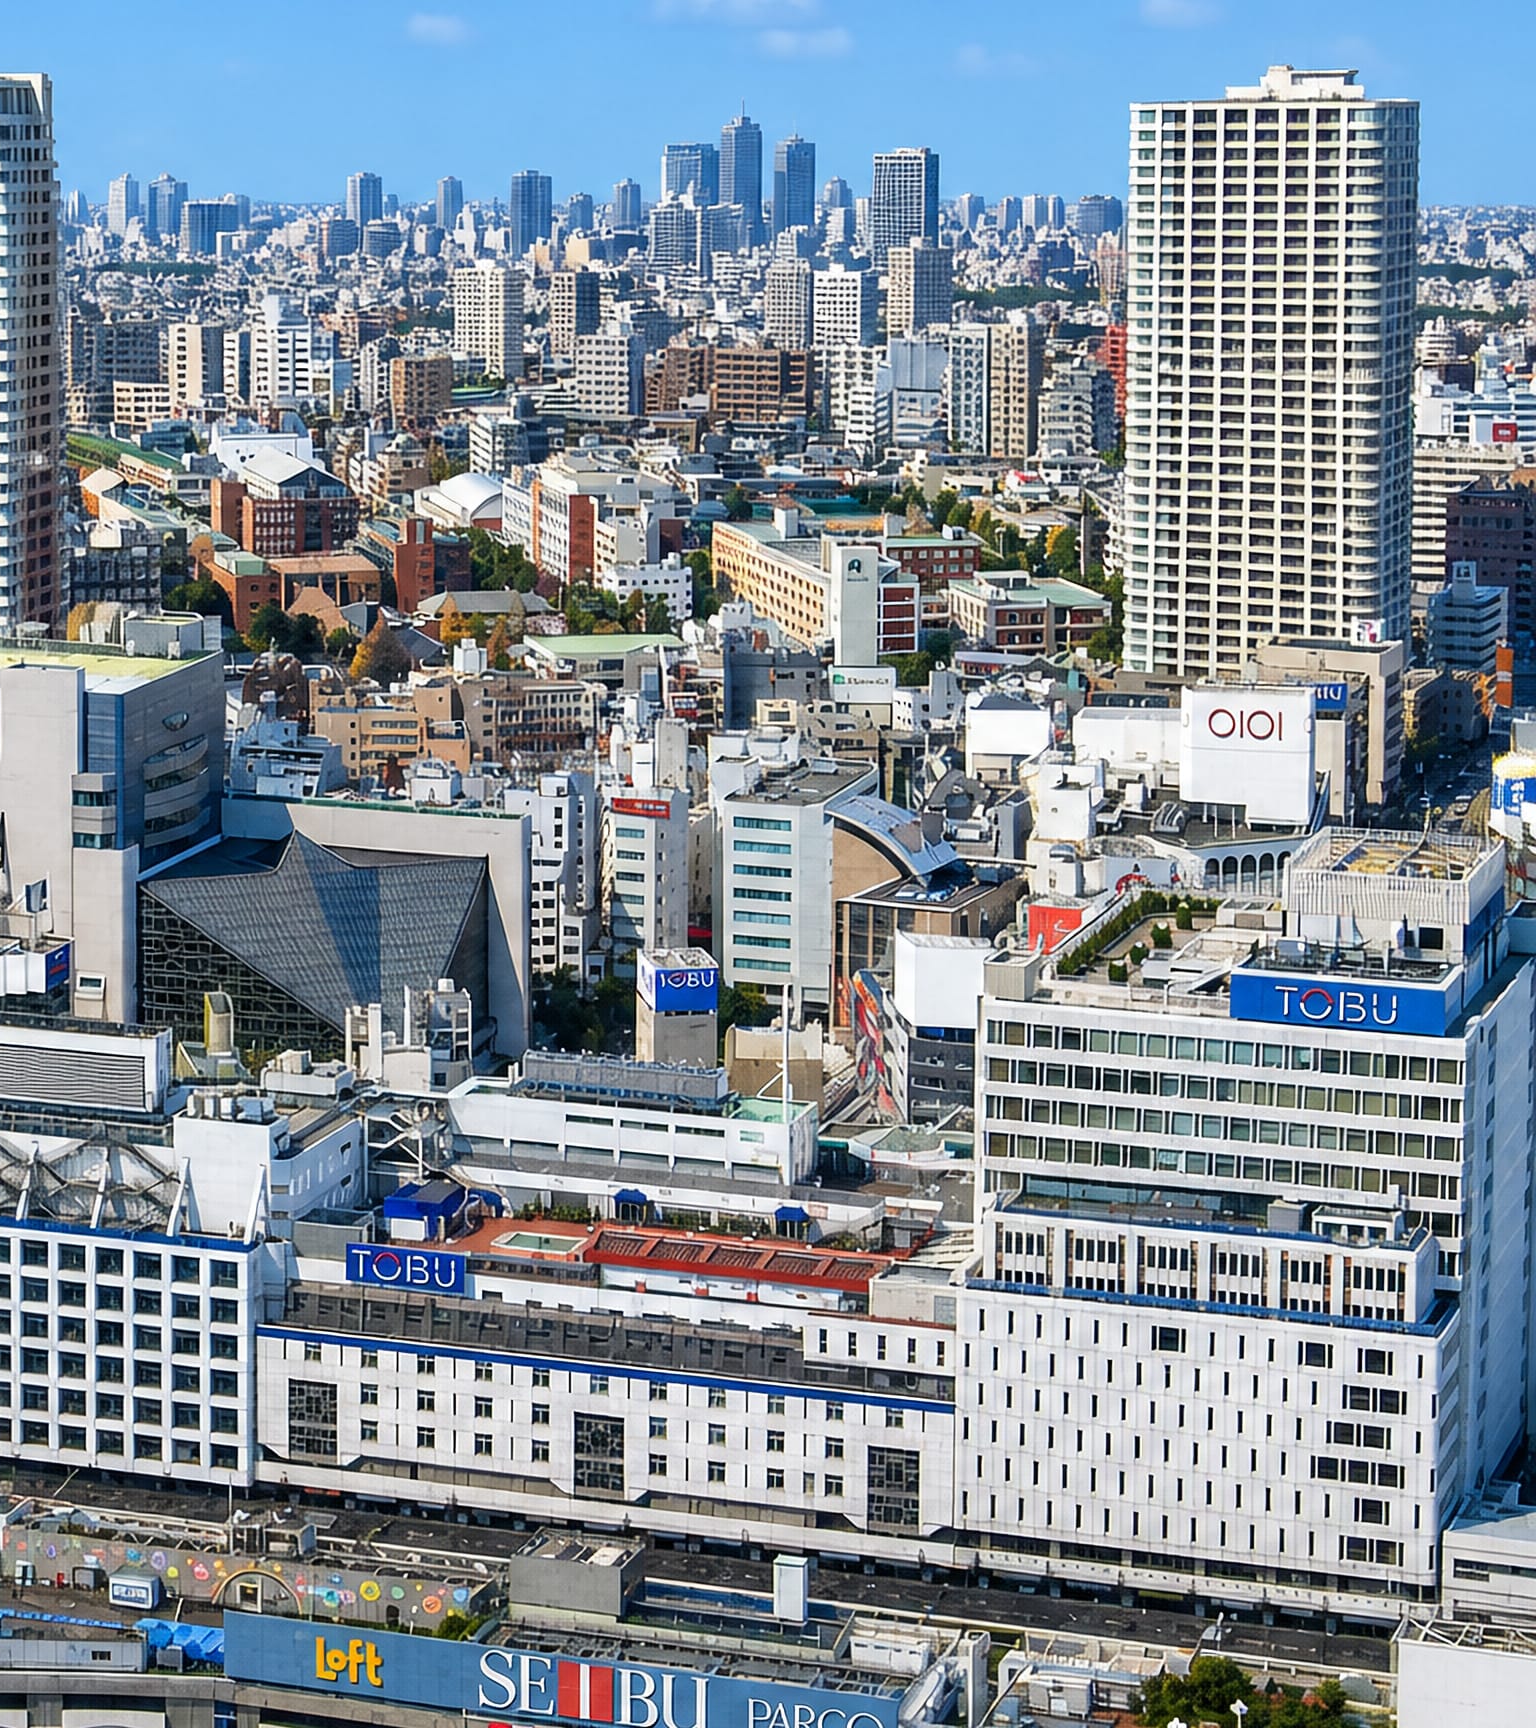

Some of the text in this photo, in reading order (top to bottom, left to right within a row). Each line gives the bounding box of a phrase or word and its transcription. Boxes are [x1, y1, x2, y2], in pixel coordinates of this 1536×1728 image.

[1274, 985, 1397, 1025] TOBU
[351, 1249, 455, 1288] TOBU
[315, 1636, 383, 1687] Loft
[478, 1649, 709, 1728] SEIBU
